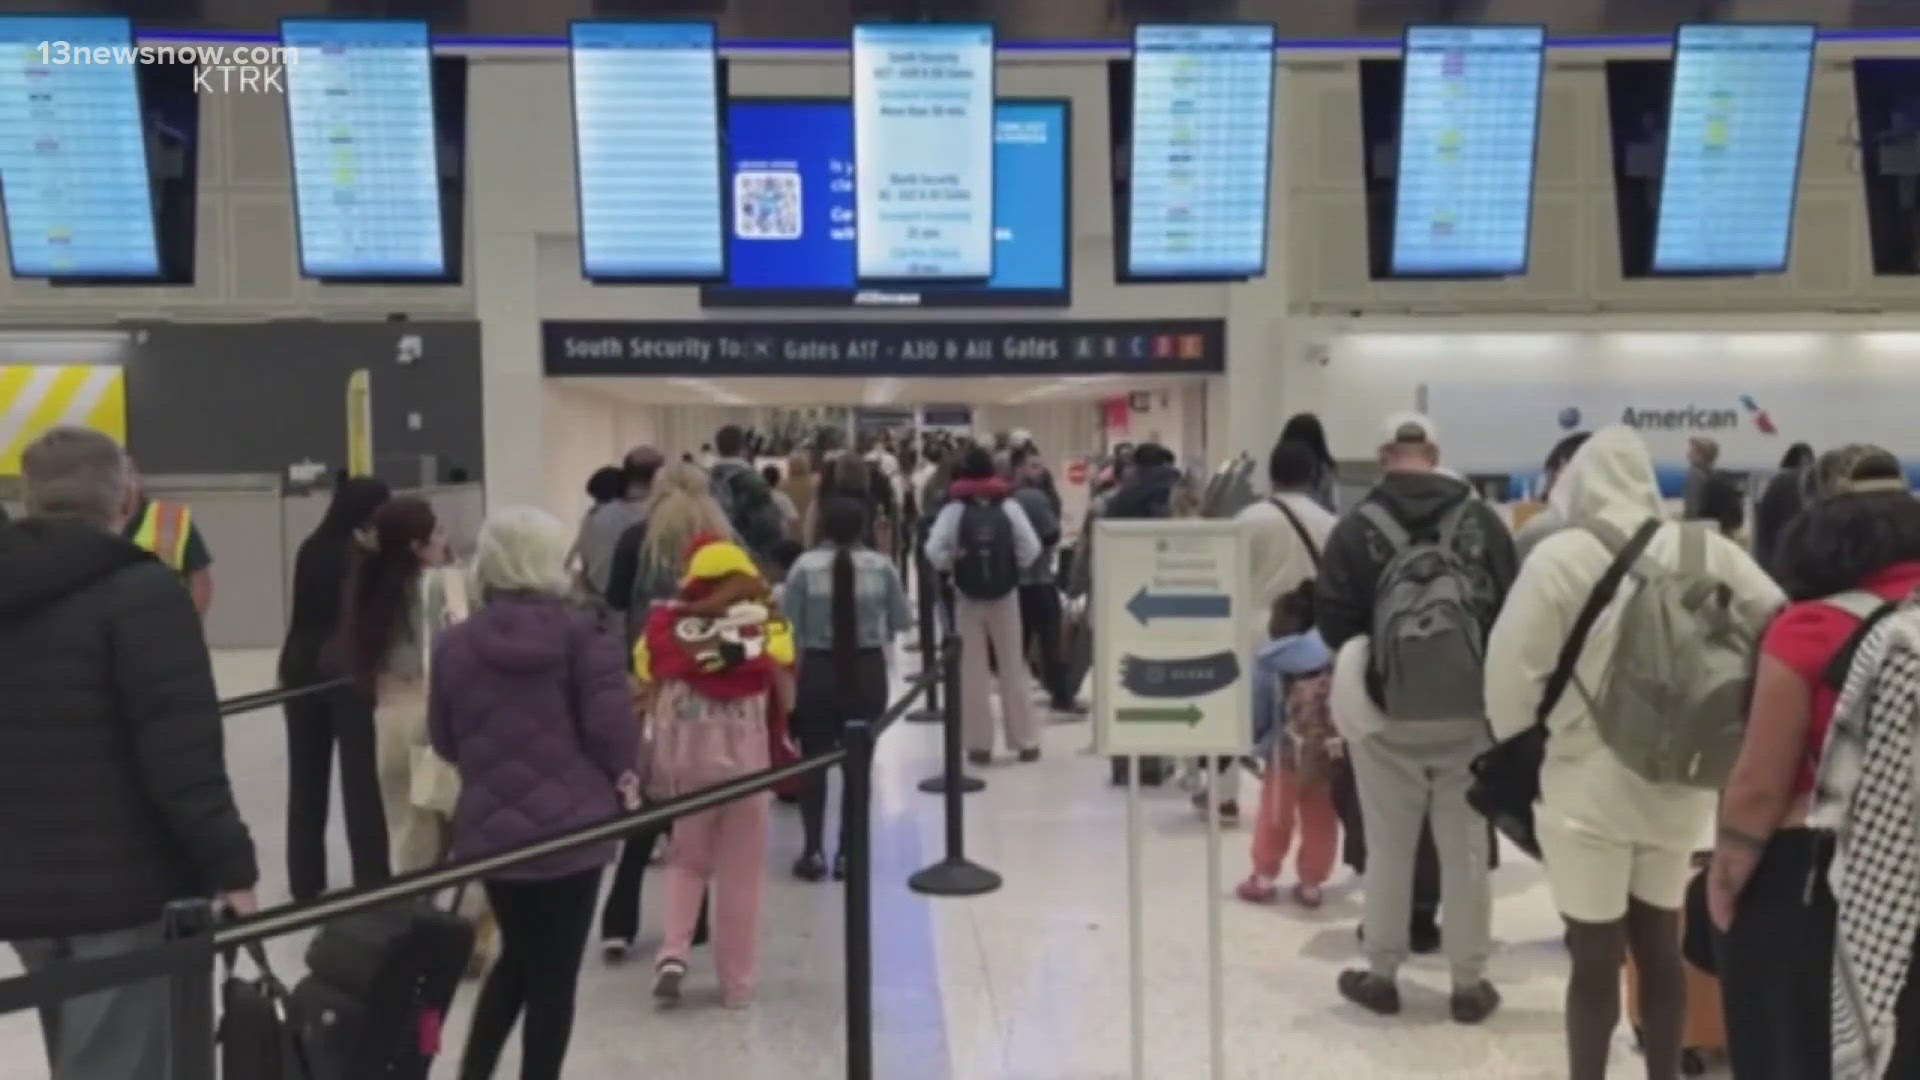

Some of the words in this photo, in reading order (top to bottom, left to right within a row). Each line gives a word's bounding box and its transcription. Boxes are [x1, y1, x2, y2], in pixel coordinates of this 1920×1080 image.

[565, 337, 622, 358] South
[630, 337, 711, 363] Security
[785, 340, 840, 360] Gates
[847, 339, 879, 360] A17
[902, 339, 939, 360] A30
[964, 338, 994, 360] All
[1002, 336, 1059, 360] Gates
[1621, 405, 1738, 430] American
